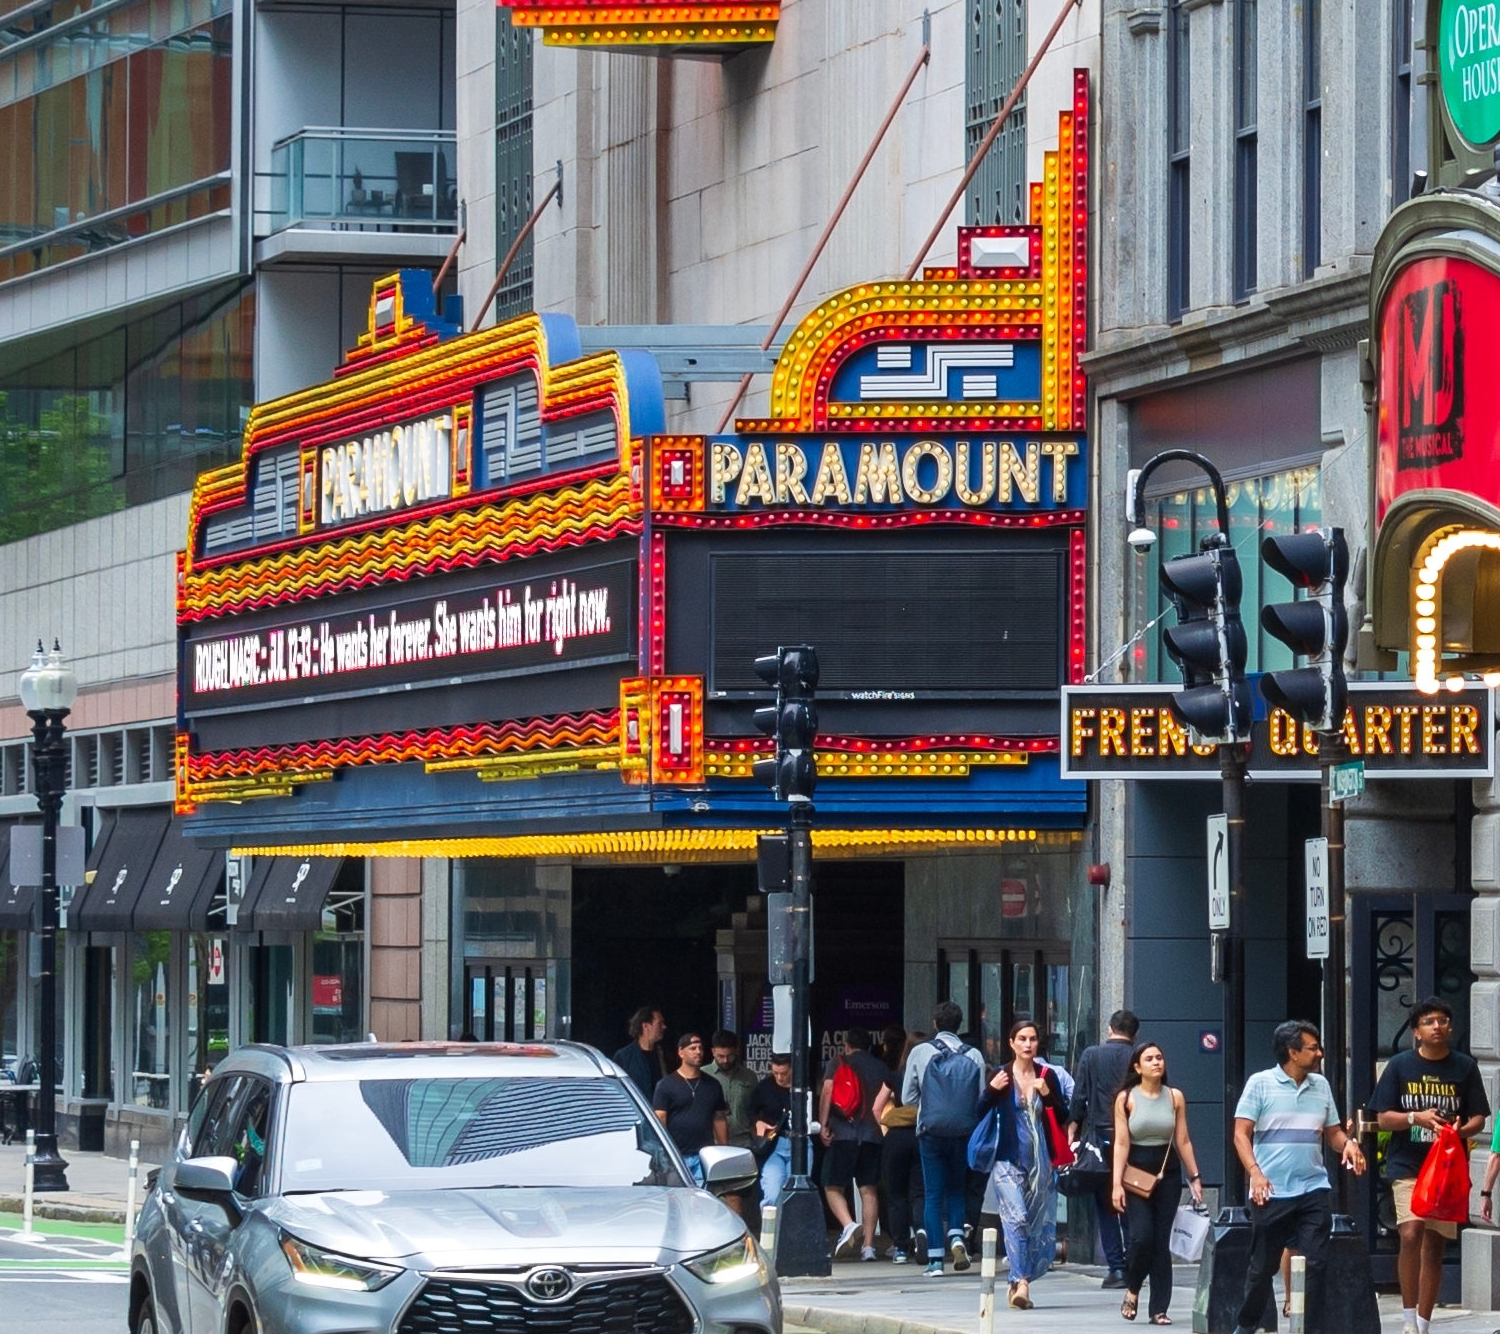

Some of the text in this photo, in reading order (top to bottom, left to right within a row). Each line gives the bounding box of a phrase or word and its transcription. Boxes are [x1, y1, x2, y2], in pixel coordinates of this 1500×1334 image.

[1402, 432, 1453, 459] THE MUSICAL
[321, 415, 453, 524] PARAMOUNT
[710, 439, 1079, 505] PARAMOUNT
[194, 641, 227, 692] ROUGH
[228, 635, 260, 688] MAGIC
[268, 631, 285, 682] JUL
[320, 624, 335, 675] He
[336, 617, 368, 670] wants
[370, 615, 389, 665] her
[390, 610, 433, 662] forever.
[435, 601, 458, 655] She
[460, 598, 496, 651] wants
[498, 589, 522, 646] him
[524, 586, 544, 643] for
[545, 579, 577, 655] right
[578, 587, 611, 633] now.
[1072, 707, 1217, 756] FREN
[1312, 856, 1321, 877] NO
[1212, 897, 1226, 916] ONLY
[1310, 886, 1324, 907] TURN
[1308, 916, 1327, 937] ON RED
[845, 999, 889, 1009] Emerson
[747, 1034, 773, 1047] JACK
[822, 1031, 829, 1045] A
[747, 1048, 773, 1060] LIEBE
[822, 1046, 846, 1060] FOR
[747, 1061, 772, 1073] BLAC
[1408, 1082, 1455, 1096] NBA FINALS
